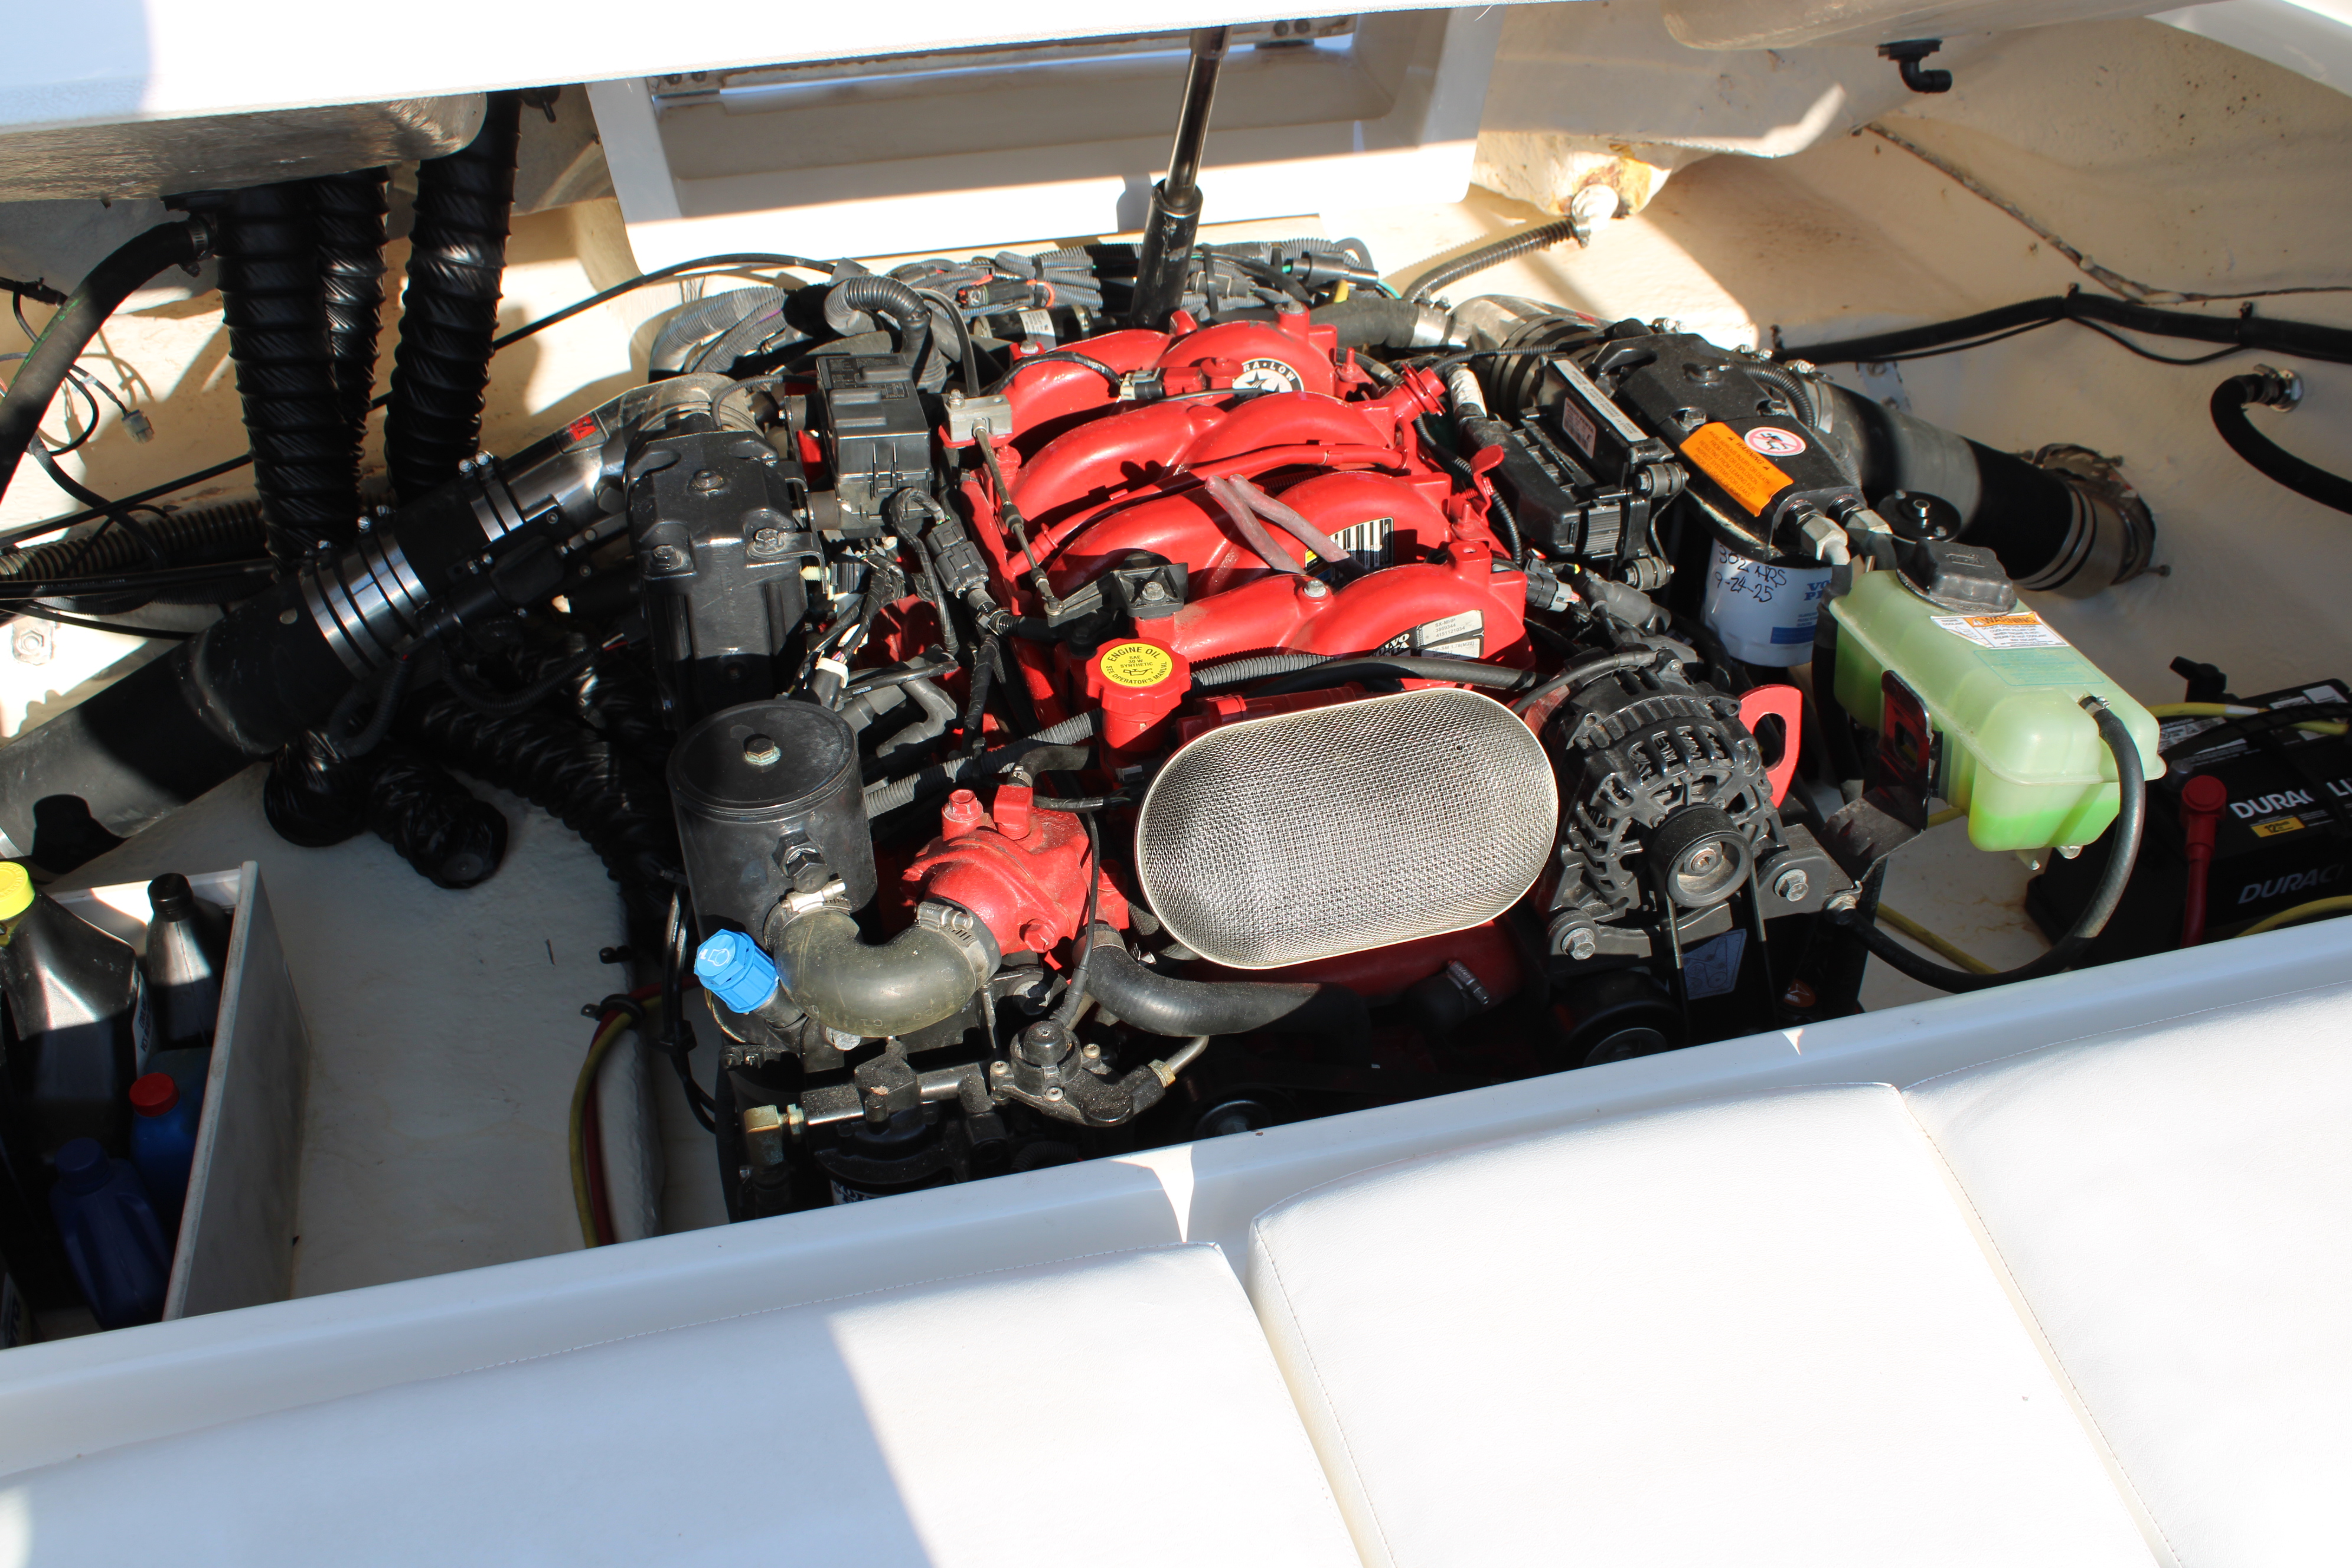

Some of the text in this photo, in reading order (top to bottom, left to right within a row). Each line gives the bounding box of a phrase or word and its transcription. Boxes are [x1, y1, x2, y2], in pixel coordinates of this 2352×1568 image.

[1270, 362, 1296, 381] LOW
[1693, 453, 1707, 466] PRIOR
[1698, 440, 1721, 459] RESULTING
[1718, 457, 1732, 469] FROM
[1729, 467, 1748, 484] LEAKING
[1710, 439, 1723, 451] FROM
[1720, 449, 1731, 459] FIRE
[1734, 462, 1760, 485] EXPLOSION
[1718, 439, 1738, 455] SERIOUS
[1734, 453, 1752, 467] INJURY
[1755, 471, 1771, 485] DEATH
[1736, 441, 1765, 465] WARNING
[1696, 446, 1752, 497] INSPECT SYSTEMS FOR LEAKS
[1435, 618, 1456, 628] SX-MHP
[1107, 646, 1161, 662] ENGINE OIL
[1106, 661, 1168, 684] SEE OPERATOR'S MANUAL
[2265, 824, 2279, 833] 12
